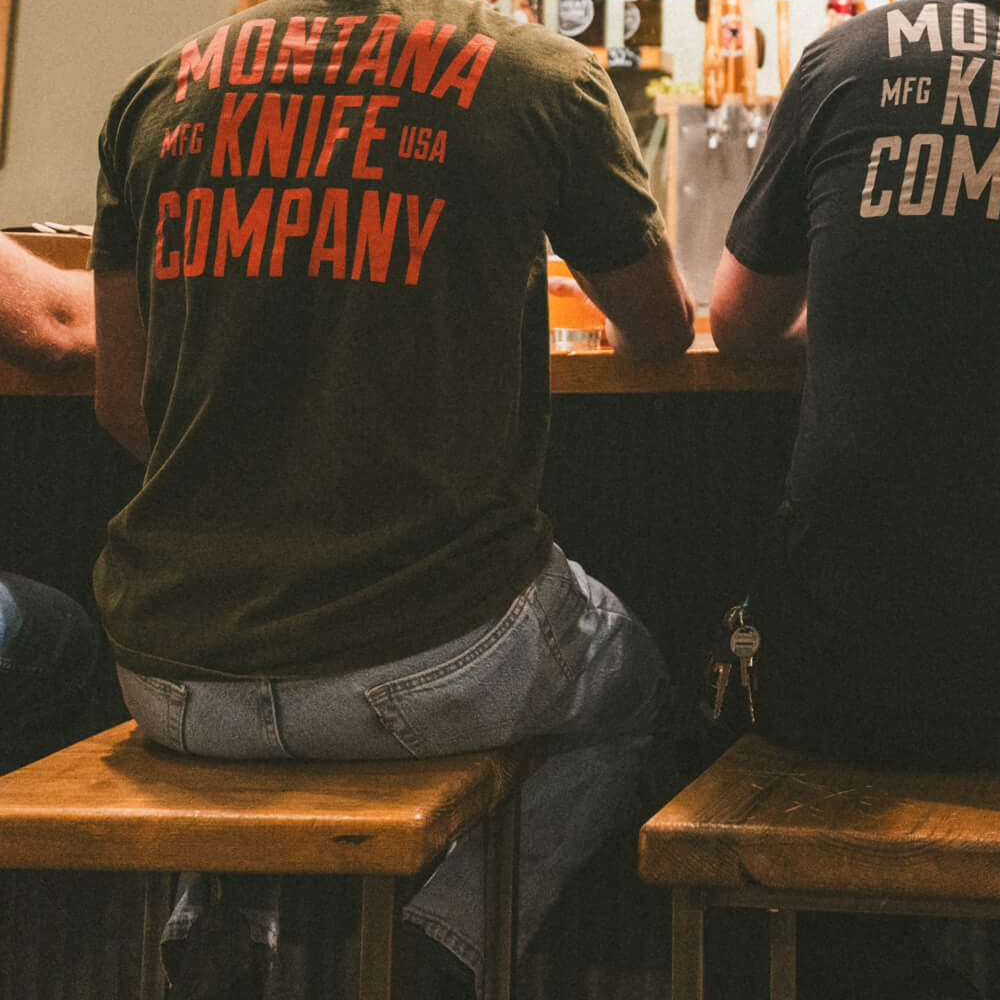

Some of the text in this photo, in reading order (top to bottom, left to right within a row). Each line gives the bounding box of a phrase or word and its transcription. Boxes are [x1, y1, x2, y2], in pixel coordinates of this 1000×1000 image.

[175, 13, 497, 109] MONTANA
[880, 76, 932, 108] MFG
[160, 91, 448, 180] MFG KNIFE USA
[154, 187, 446, 286] COMPANY
